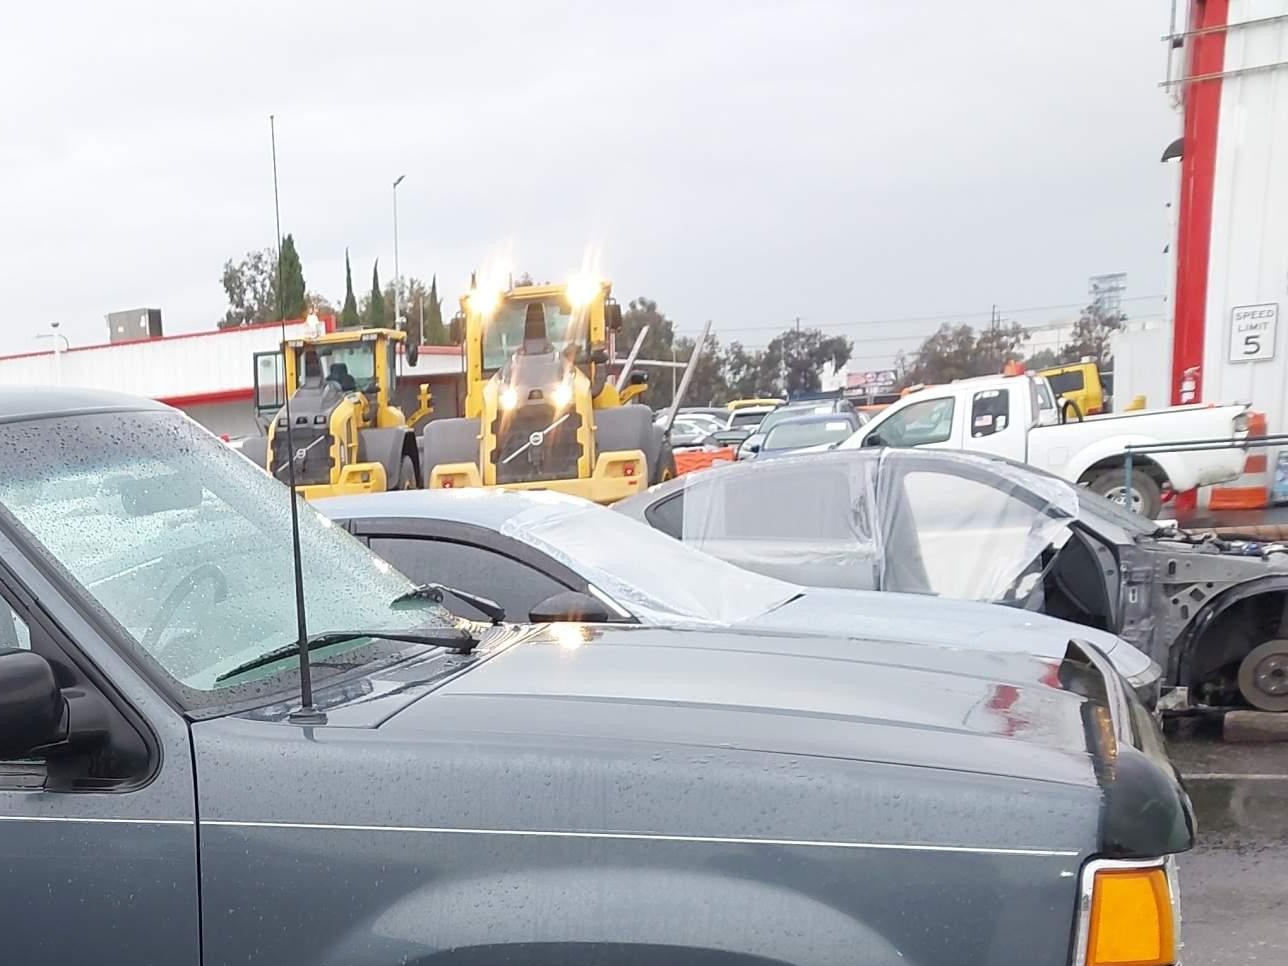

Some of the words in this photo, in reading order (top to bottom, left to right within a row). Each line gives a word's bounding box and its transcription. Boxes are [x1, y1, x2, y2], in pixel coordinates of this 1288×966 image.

[1235, 310, 1274, 320] SPEED
[1238, 322, 1269, 332] LIMIT
[1243, 335, 1261, 355] 5
